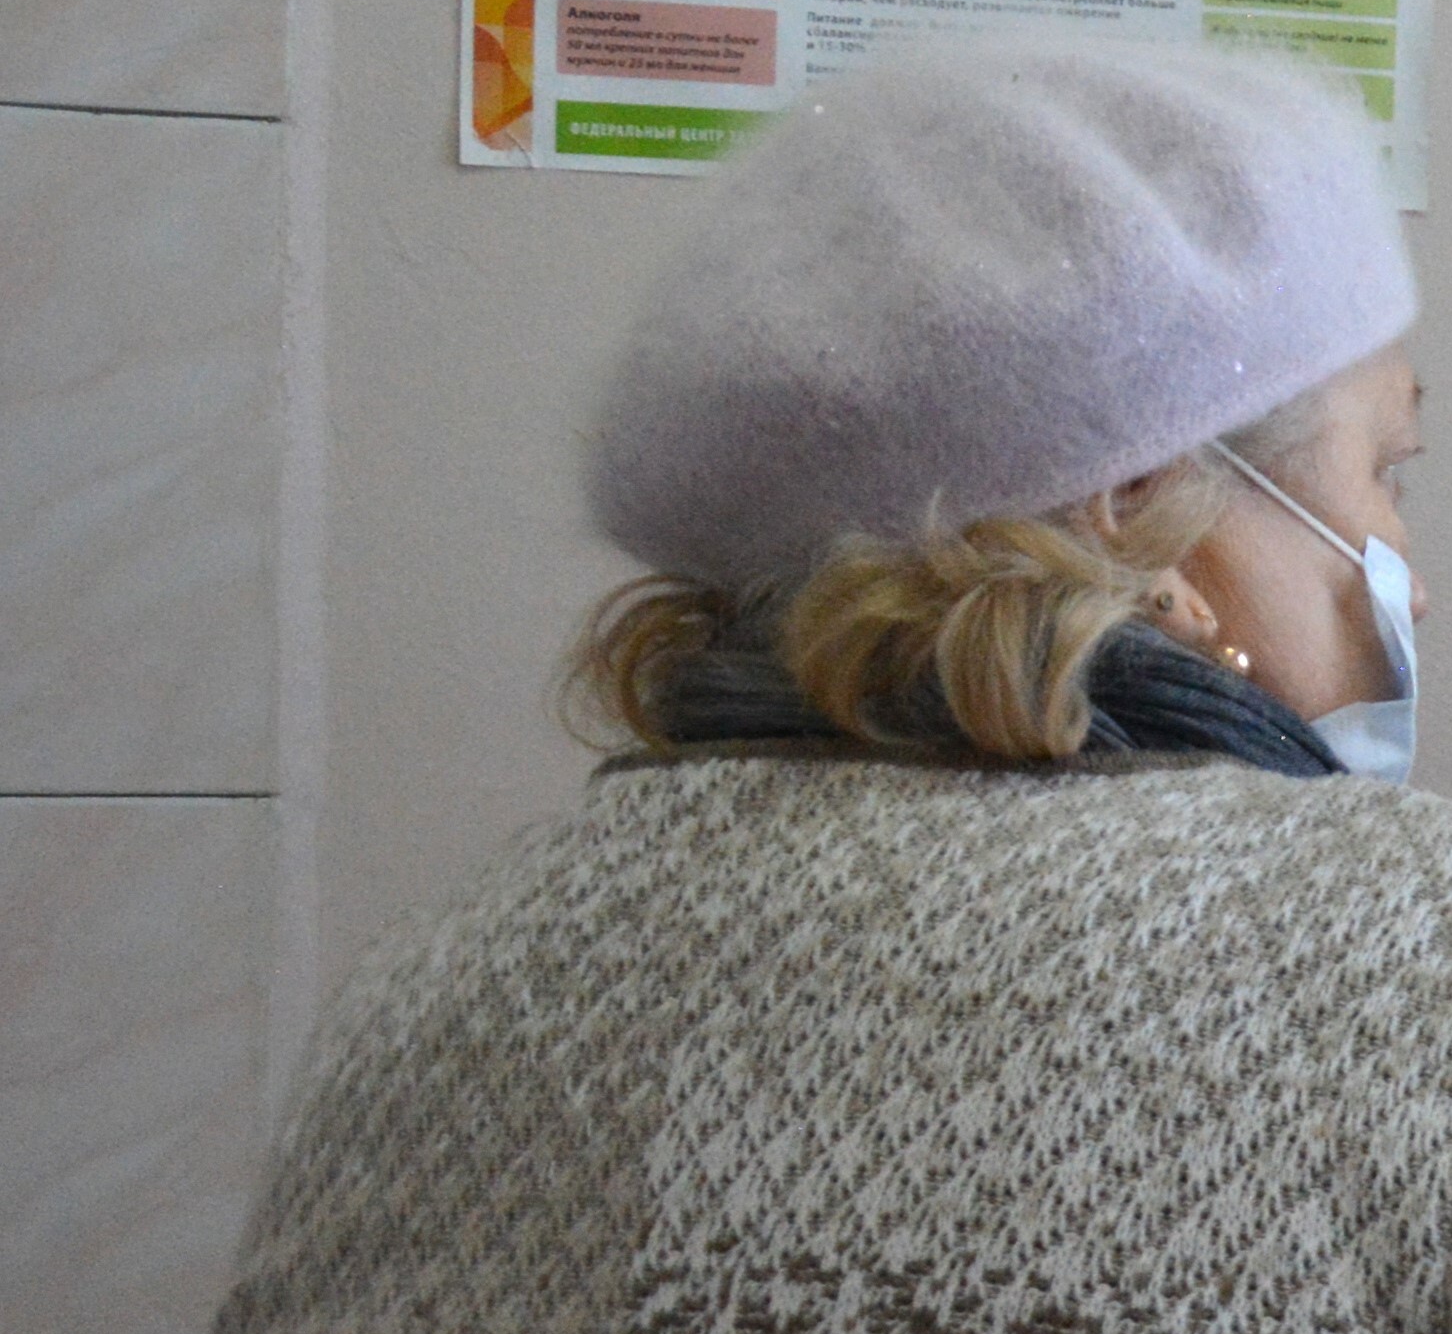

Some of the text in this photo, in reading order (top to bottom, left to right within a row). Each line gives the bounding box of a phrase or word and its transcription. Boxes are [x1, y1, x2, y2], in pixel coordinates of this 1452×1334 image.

[567, 6, 641, 23] Алкоголя
[807, 11, 862, 27] Питание
[569, 121, 677, 141] ФЕДЕРАЛЬНЫЙ
[680, 126, 725, 143] ЦЕНТР
